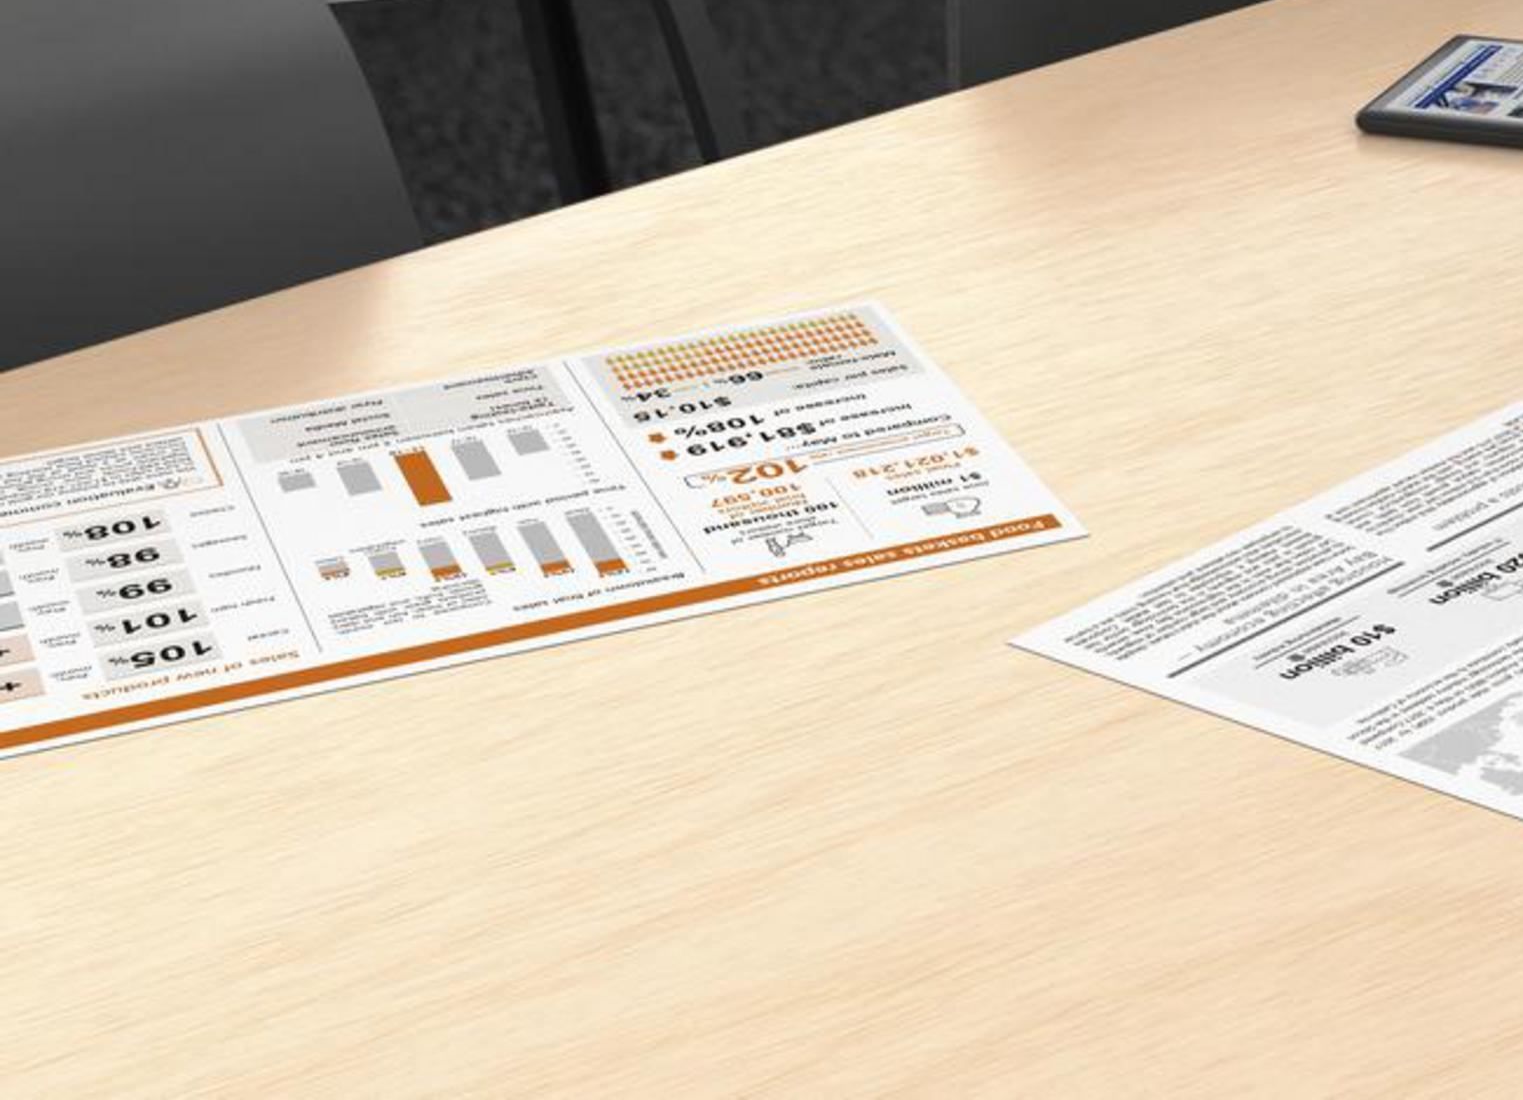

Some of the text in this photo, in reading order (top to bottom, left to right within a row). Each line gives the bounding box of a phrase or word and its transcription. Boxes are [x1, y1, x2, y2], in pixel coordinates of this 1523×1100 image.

[629, 395, 735, 424] $10.15
[670, 392, 868, 440] Increase of 108%
[838, 412, 953, 441] Compared to
[681, 402, 913, 458] Increase of $81,919
[697, 454, 811, 491] 102%
[883, 471, 983, 498] $1 million
[64, 482, 157, 506] Evaluation
[60, 513, 163, 546] 108%
[699, 500, 839, 535] 100 thousand
[82, 545, 162, 574] 98%
[754, 517, 1047, 587] Food baskets sales reports
[93, 576, 175, 606] 99%
[1422, 569, 1504, 607] billion
[92, 605, 200, 641] 101%
[106, 637, 215, 675] 105%
[1273, 621, 1400, 682] $10 billion
[80, 648, 300, 702] Sales of new products
